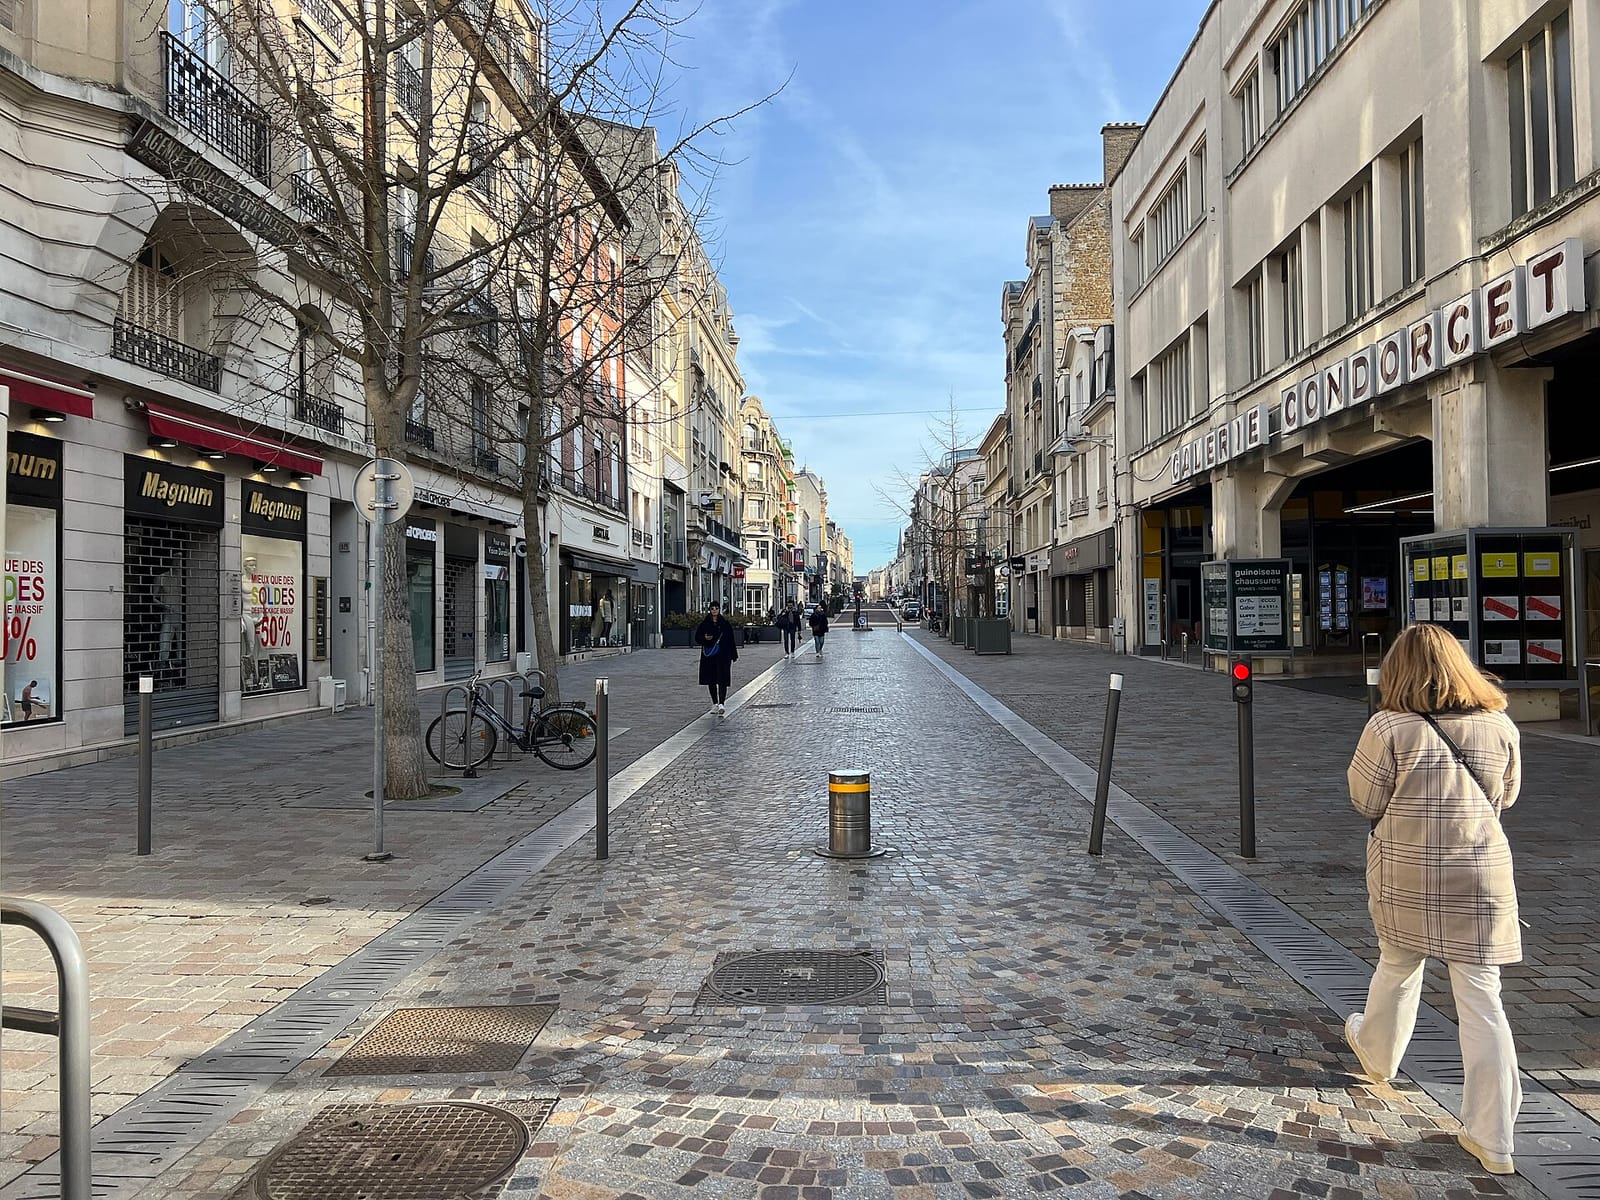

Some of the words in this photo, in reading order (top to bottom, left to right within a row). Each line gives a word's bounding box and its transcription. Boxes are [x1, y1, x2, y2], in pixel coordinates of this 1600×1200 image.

[141, 128, 184, 165] AGENCE
[1172, 410, 1259, 480] GALERIE
[1285, 252, 1564, 427] CONDORCET
[142, 472, 214, 507] Magnum
[250, 492, 302, 522] Magnum
[22, 560, 44, 574] DES
[1235, 568, 1280, 577] guinoiseau
[251, 574, 269, 584] MIEUX
[271, 575, 282, 585] QUE
[283, 576, 294, 585] DES
[251, 587, 295, 605] SOLDES
[15, 605, 44, 614] MASSIF
[280, 607, 294, 615] MASSIF
[255, 615, 291, 647] -50%
